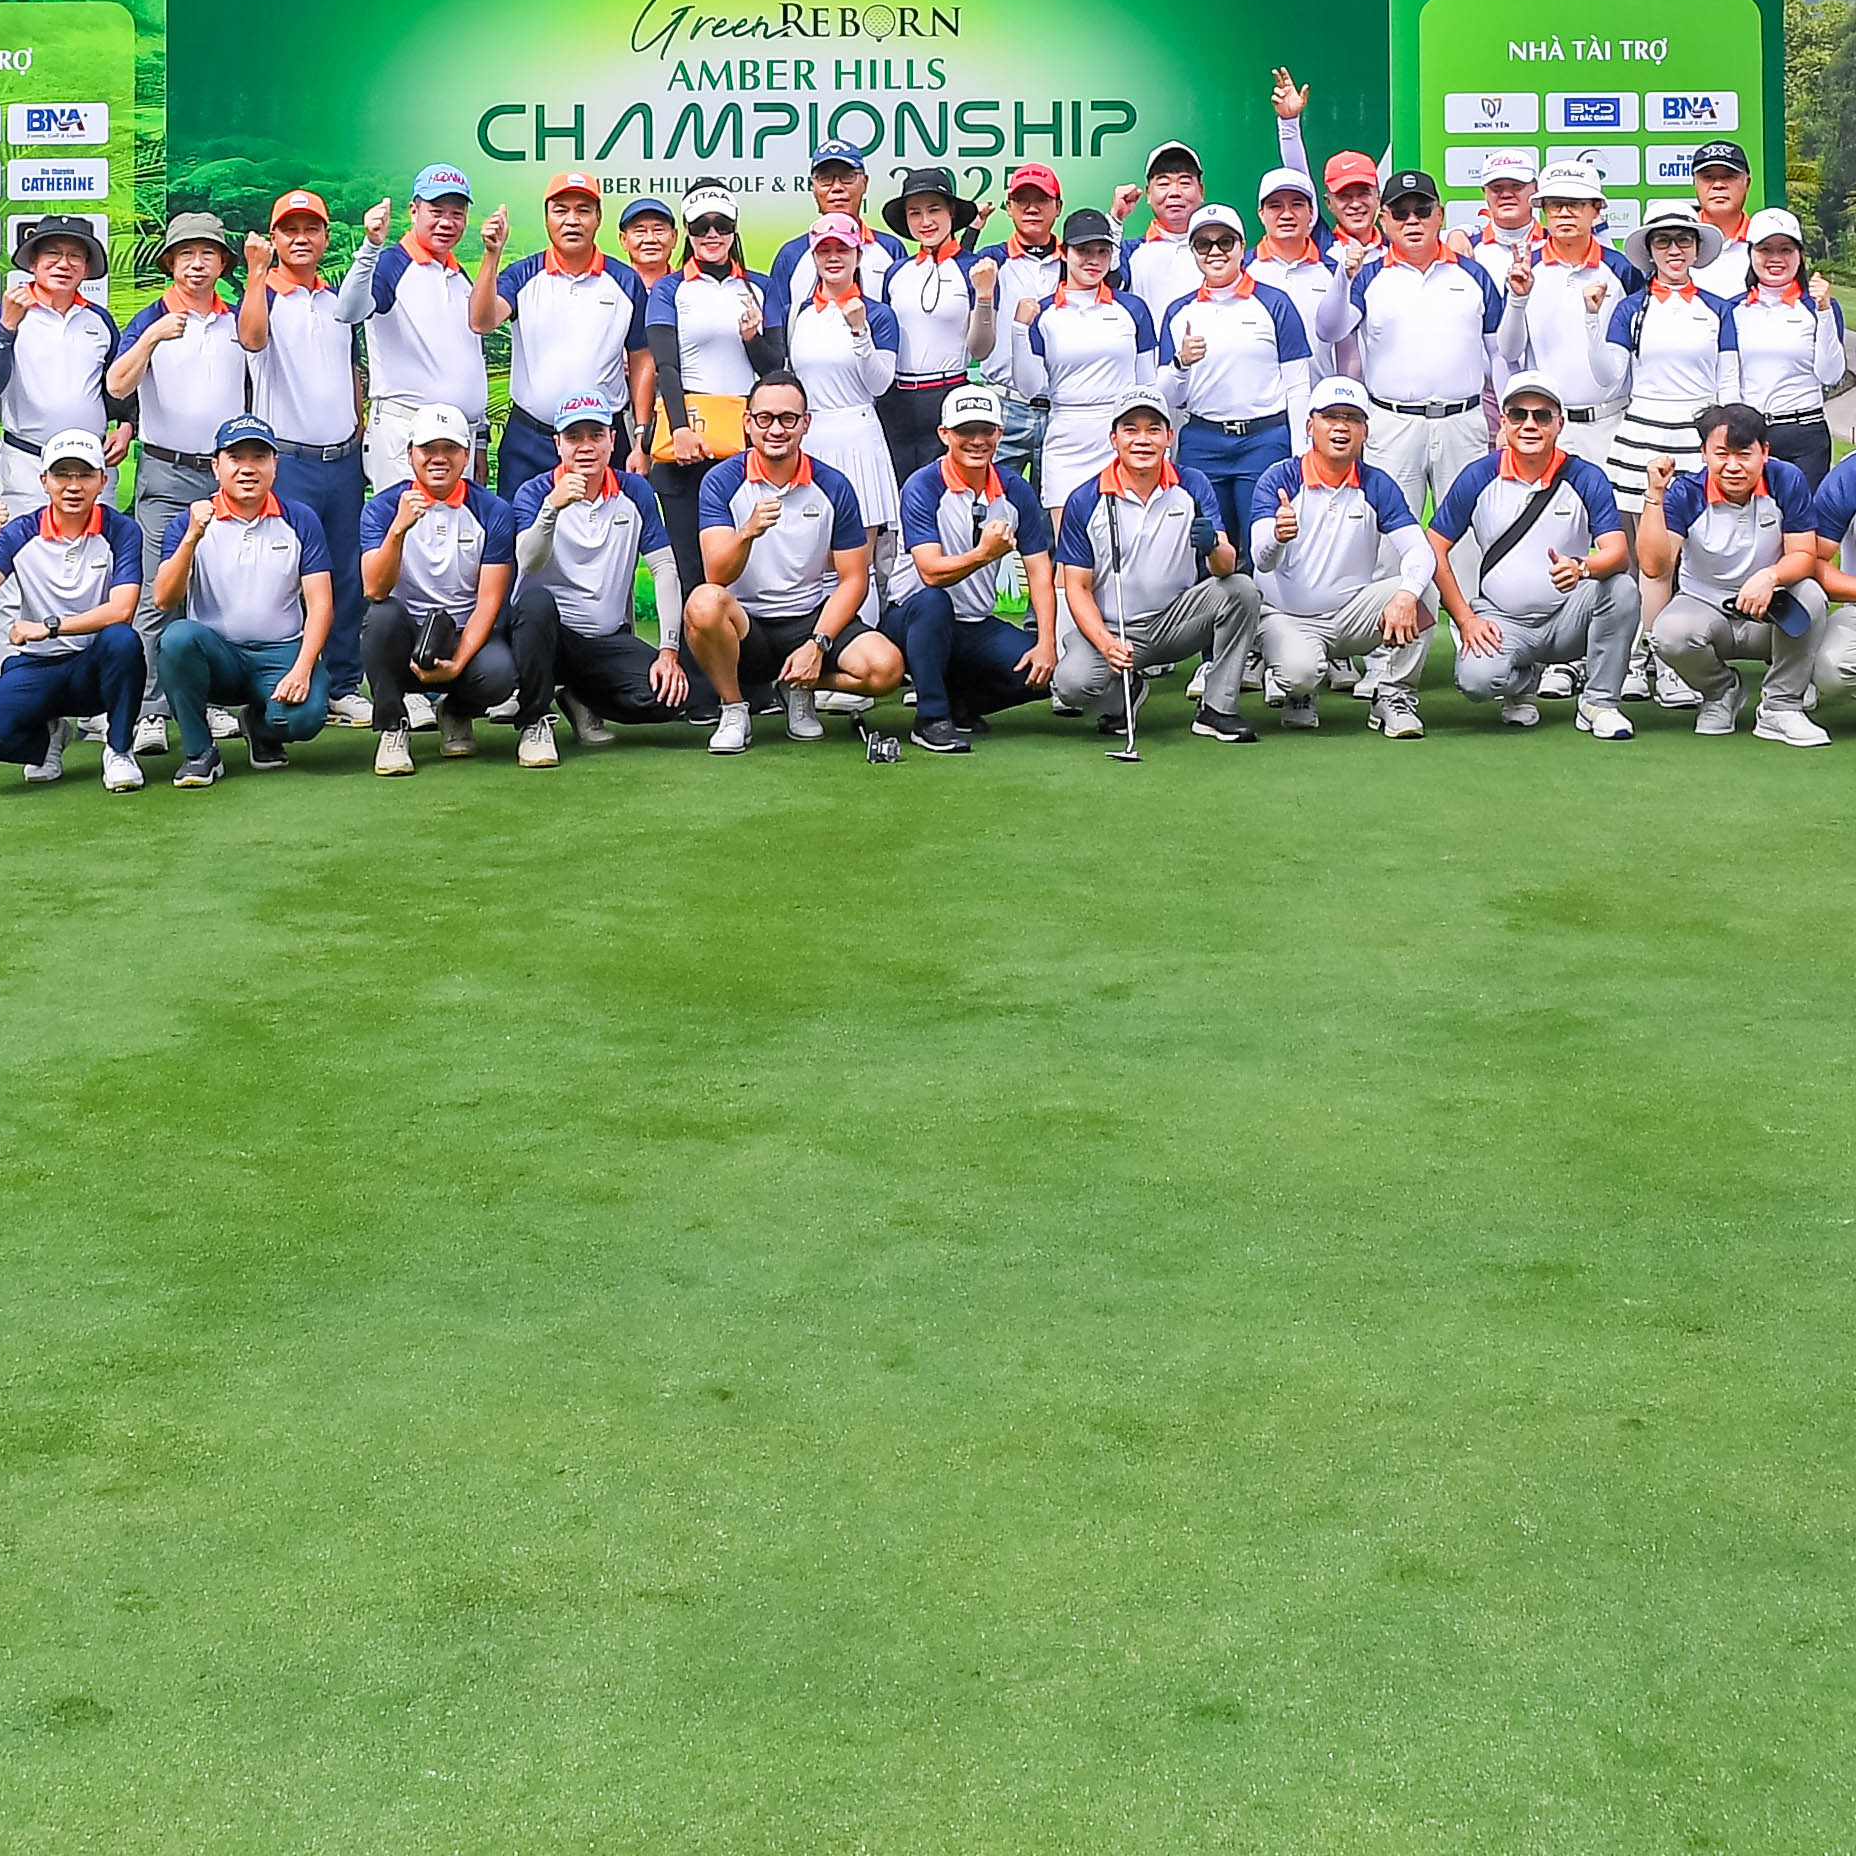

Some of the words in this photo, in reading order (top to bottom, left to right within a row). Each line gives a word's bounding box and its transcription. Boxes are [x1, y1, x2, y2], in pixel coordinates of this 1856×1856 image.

[1508, 34, 1566, 61] NHÀ
[1571, 34, 1611, 61] TÀI
[1619, 37, 1668, 66] TRỢ
[666, 59, 817, 92] AMBER
[834, 57, 947, 92] HILLS
[1663, 97, 1717, 119] BNA
[27, 109, 86, 132] BNA
[475, 99, 1138, 162] CHAMPIONSHIP
[22, 177, 95, 192] CATHERINE
[771, 177, 787, 192] &
[956, 398, 992, 412] PING
